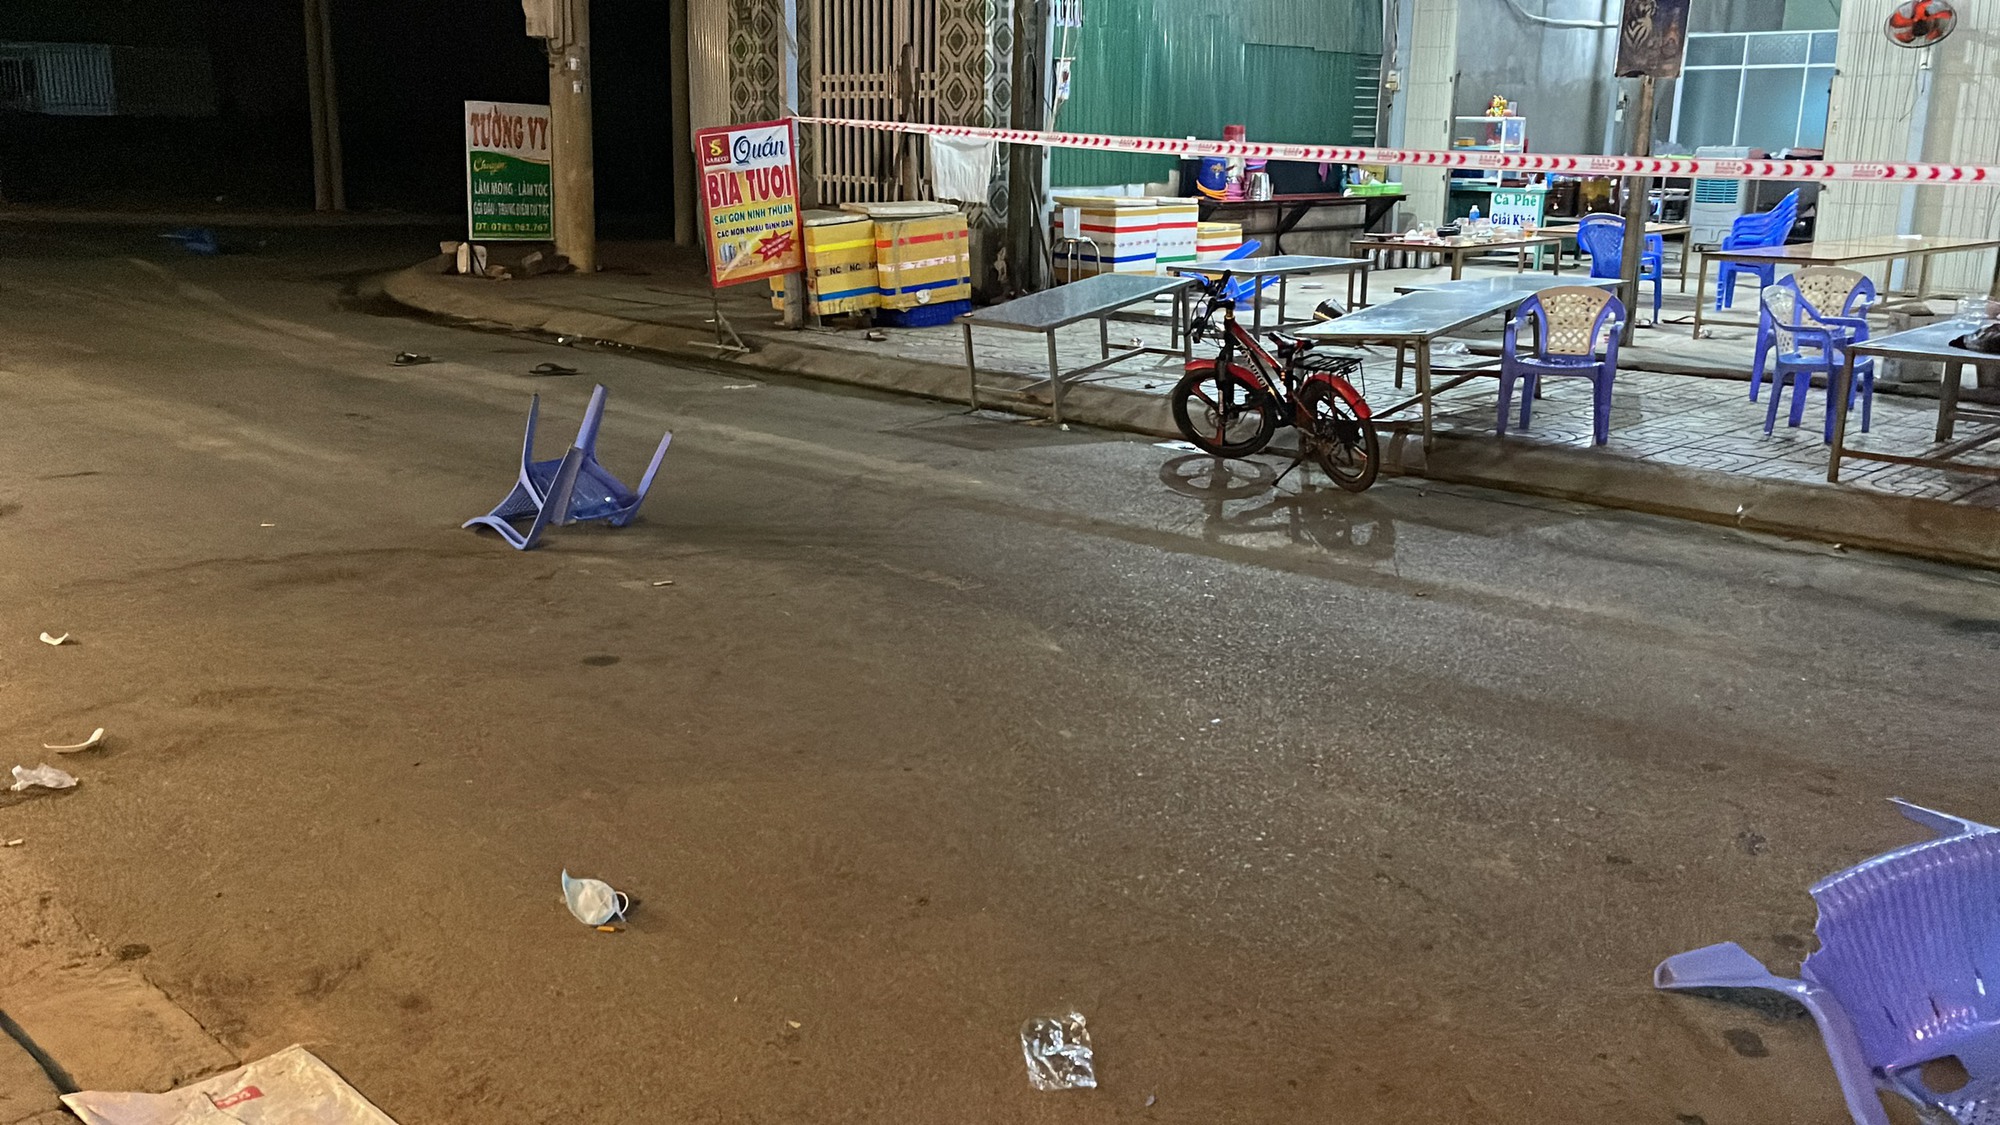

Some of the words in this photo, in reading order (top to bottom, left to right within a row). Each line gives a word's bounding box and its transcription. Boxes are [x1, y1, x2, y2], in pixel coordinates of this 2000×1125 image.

[470, 105, 523, 149] TƯỜNG
[527, 116, 549, 150] VY
[733, 135, 784, 164] Quán
[706, 171, 743, 208] BIA
[745, 164, 792, 201] TƯƠI
[747, 208, 766, 220] NINH
[829, 265, 842, 275] NC
[850, 262, 861, 271] NC
